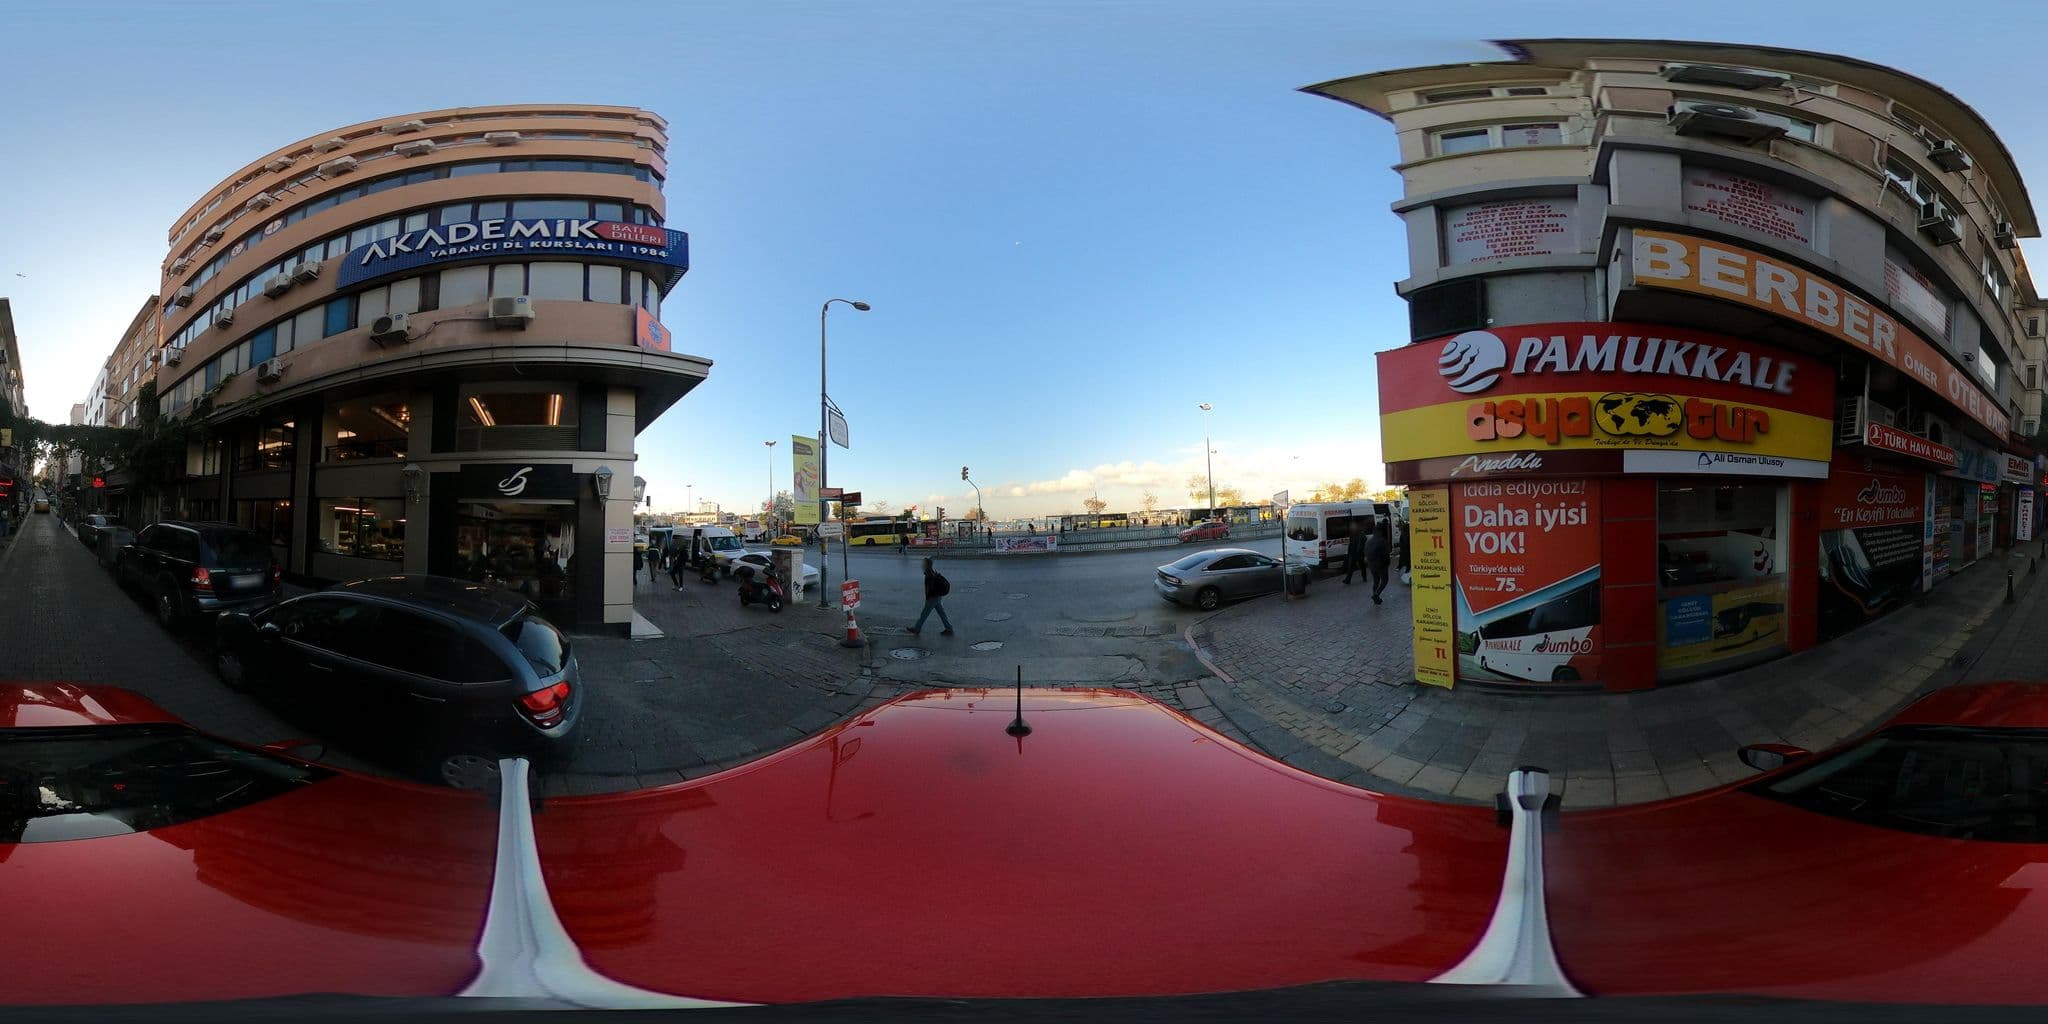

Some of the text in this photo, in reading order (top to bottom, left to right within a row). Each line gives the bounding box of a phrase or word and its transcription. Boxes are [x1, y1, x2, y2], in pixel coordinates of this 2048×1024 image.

[611, 224, 644, 234] BATI
[430, 242, 498, 258] YABANCI
[530, 240, 613, 252] KURSLARI
[632, 246, 668, 259] 1984
[1632, 235, 1899, 360] BERBER
[1511, 334, 1796, 395] PAMUKKALE
[1466, 396, 1770, 445] asya tur
[1884, 431, 1908, 450] TÜRK
[1910, 440, 1931, 457] HAVA
[1451, 453, 1542, 476] Anadolu
[1713, 453, 1785, 468] Ali Osman Ulusoy
[1464, 501, 1588, 533] Daha iyisi
[1432, 535, 1445, 549] TL
[1464, 531, 1525, 555] YOK!
[1469, 564, 1509, 575] Türkiye'de
[1496, 577, 1517, 592] 75
[1434, 647, 1447, 660] TL
